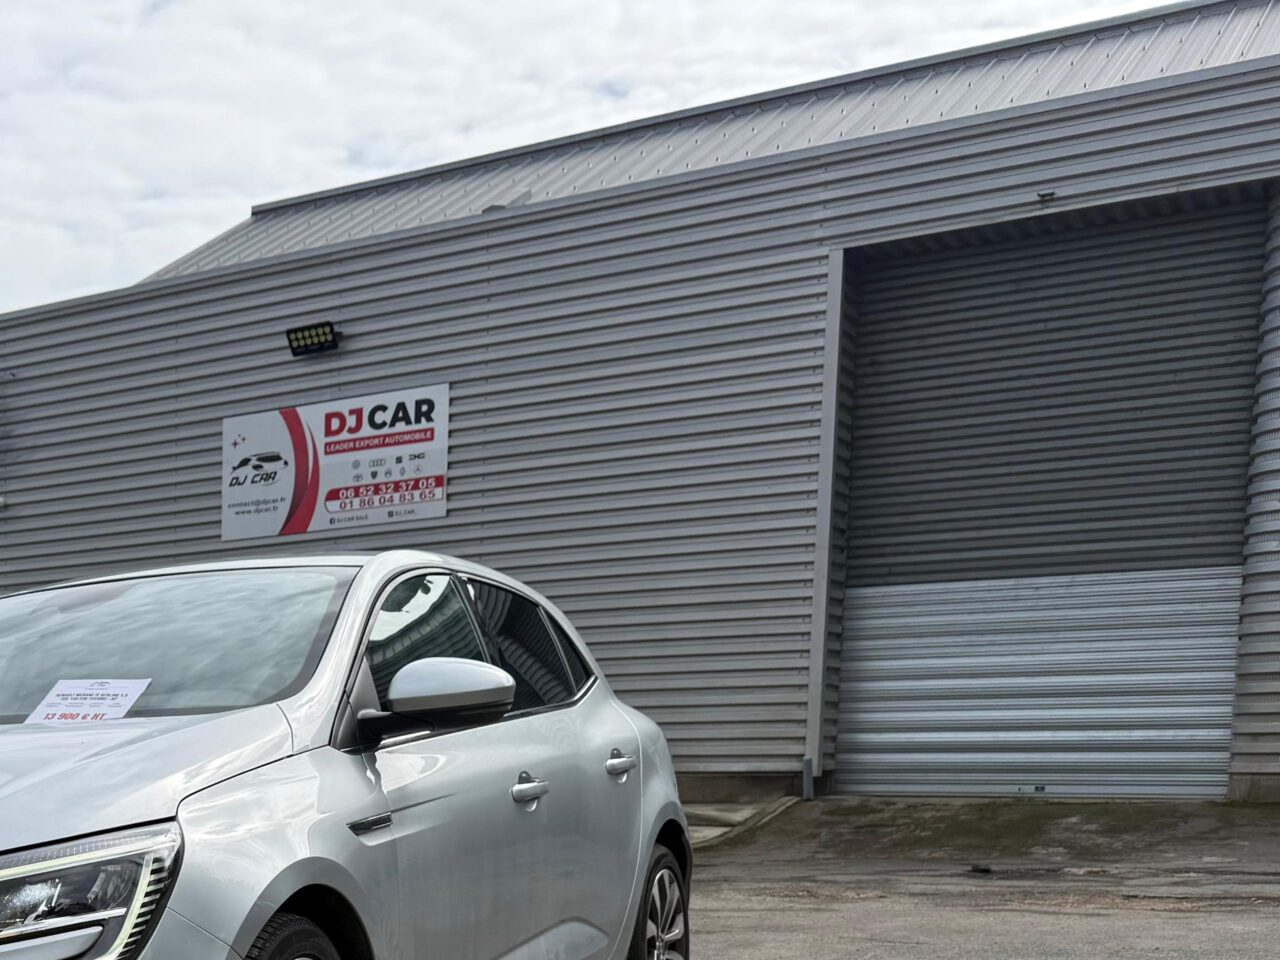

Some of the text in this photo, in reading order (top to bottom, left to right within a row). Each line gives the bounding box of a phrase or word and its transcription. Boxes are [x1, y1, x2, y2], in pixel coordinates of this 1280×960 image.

[324, 398, 436, 438] DJ CAR
[325, 430, 433, 453] LEADER EXPORT AUTOMOBILE
[228, 471, 278, 488] DJ CAR
[339, 478, 436, 499] 06 52 32 37 05
[339, 489, 436, 510] 01 86 04 83 65
[43, 712, 57, 720] 13
[57, 712, 80, 720] 900
[91, 712, 108, 720] HT
